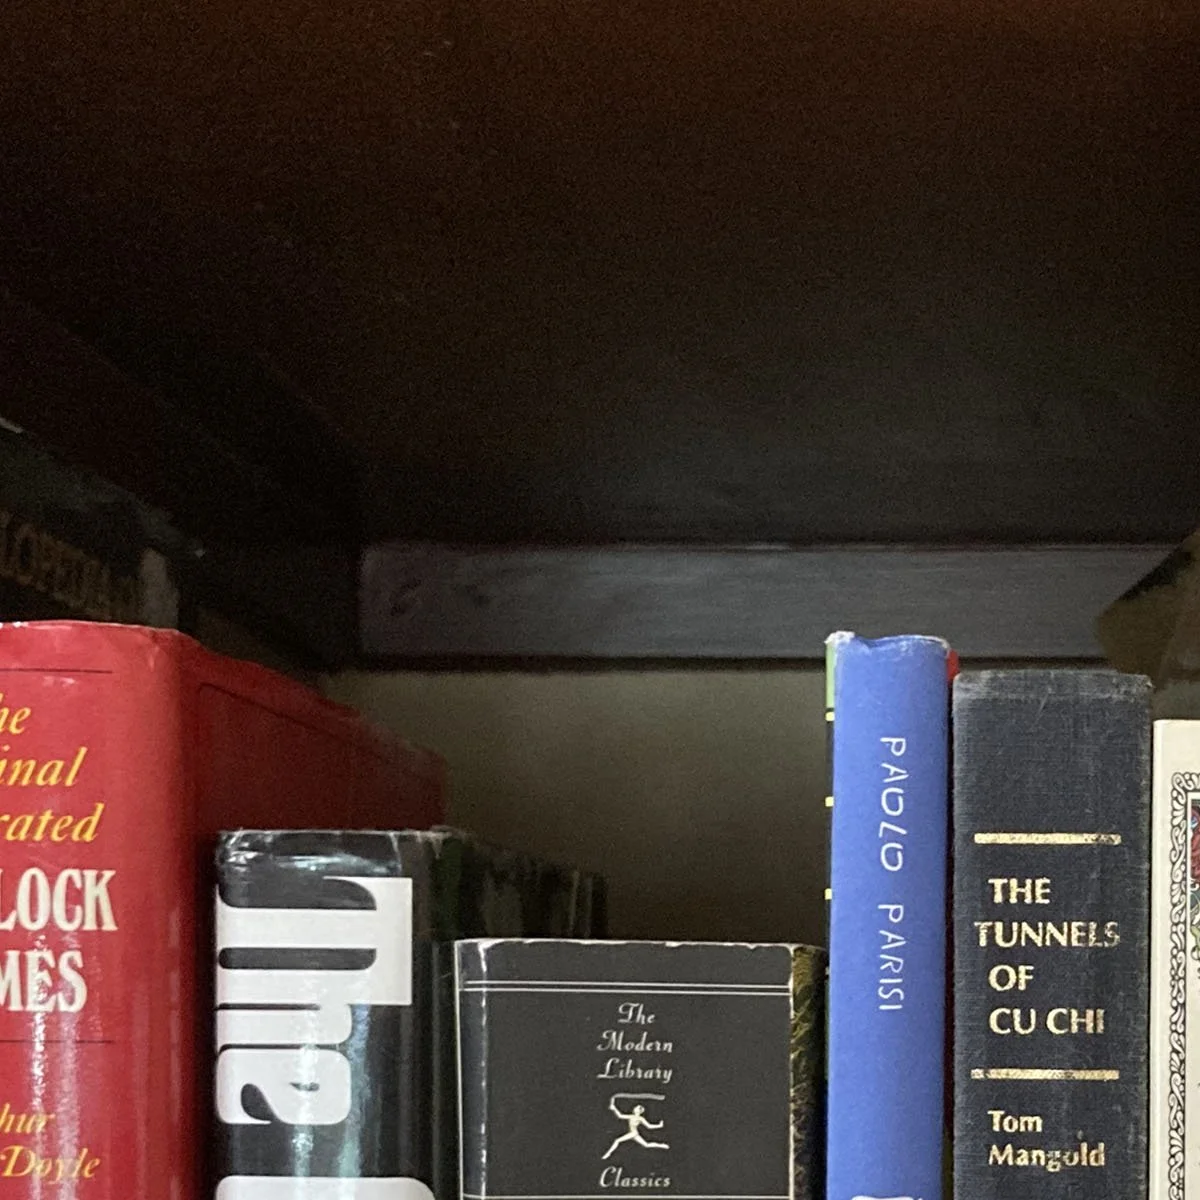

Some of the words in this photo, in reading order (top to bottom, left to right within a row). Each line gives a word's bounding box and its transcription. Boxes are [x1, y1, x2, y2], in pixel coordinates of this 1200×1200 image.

[879, 737, 909, 872] PAOLO
[988, 877, 1051, 904] THE
[974, 921, 1121, 947] TUNNELS
[878, 904, 907, 1010] PARISI
[988, 964, 1034, 991] OF
[214, 875, 412, 1125] The
[618, 1002, 655, 1025] The
[989, 1008, 1036, 1034] CU
[1046, 1008, 1105, 1034] CHI
[597, 1030, 673, 1053] Modern
[597, 1057, 673, 1084] Library
[987, 1110, 1043, 1133] Tom
[988, 1142, 1105, 1172] Mangold
[600, 1166, 671, 1188] Classics
